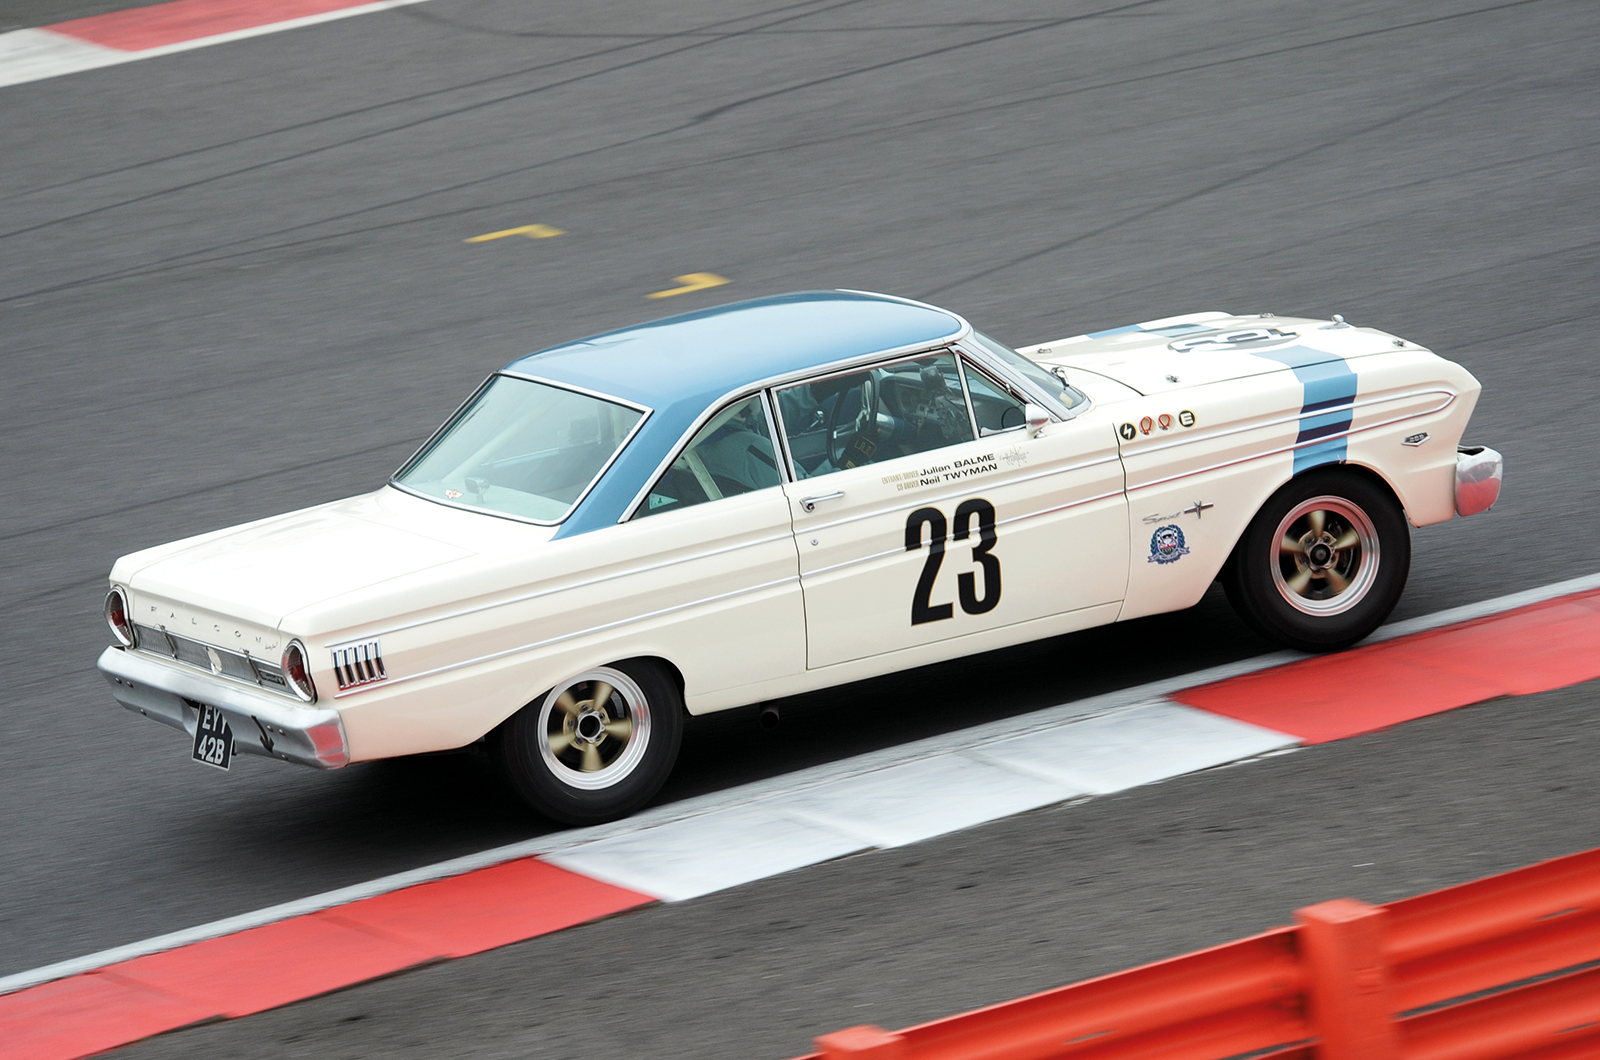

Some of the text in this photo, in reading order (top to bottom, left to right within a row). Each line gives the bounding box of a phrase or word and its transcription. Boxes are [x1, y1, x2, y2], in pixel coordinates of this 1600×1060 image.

[920, 464, 951, 477] Julian
[953, 453, 996, 468] BALME
[920, 476, 941, 487] Neil
[942, 463, 998, 482] TWYMAN
[905, 497, 1002, 627] 23
[150, 605, 262, 643] FALCON
[202, 704, 227, 735] EYY
[198, 734, 225, 765] 42B
